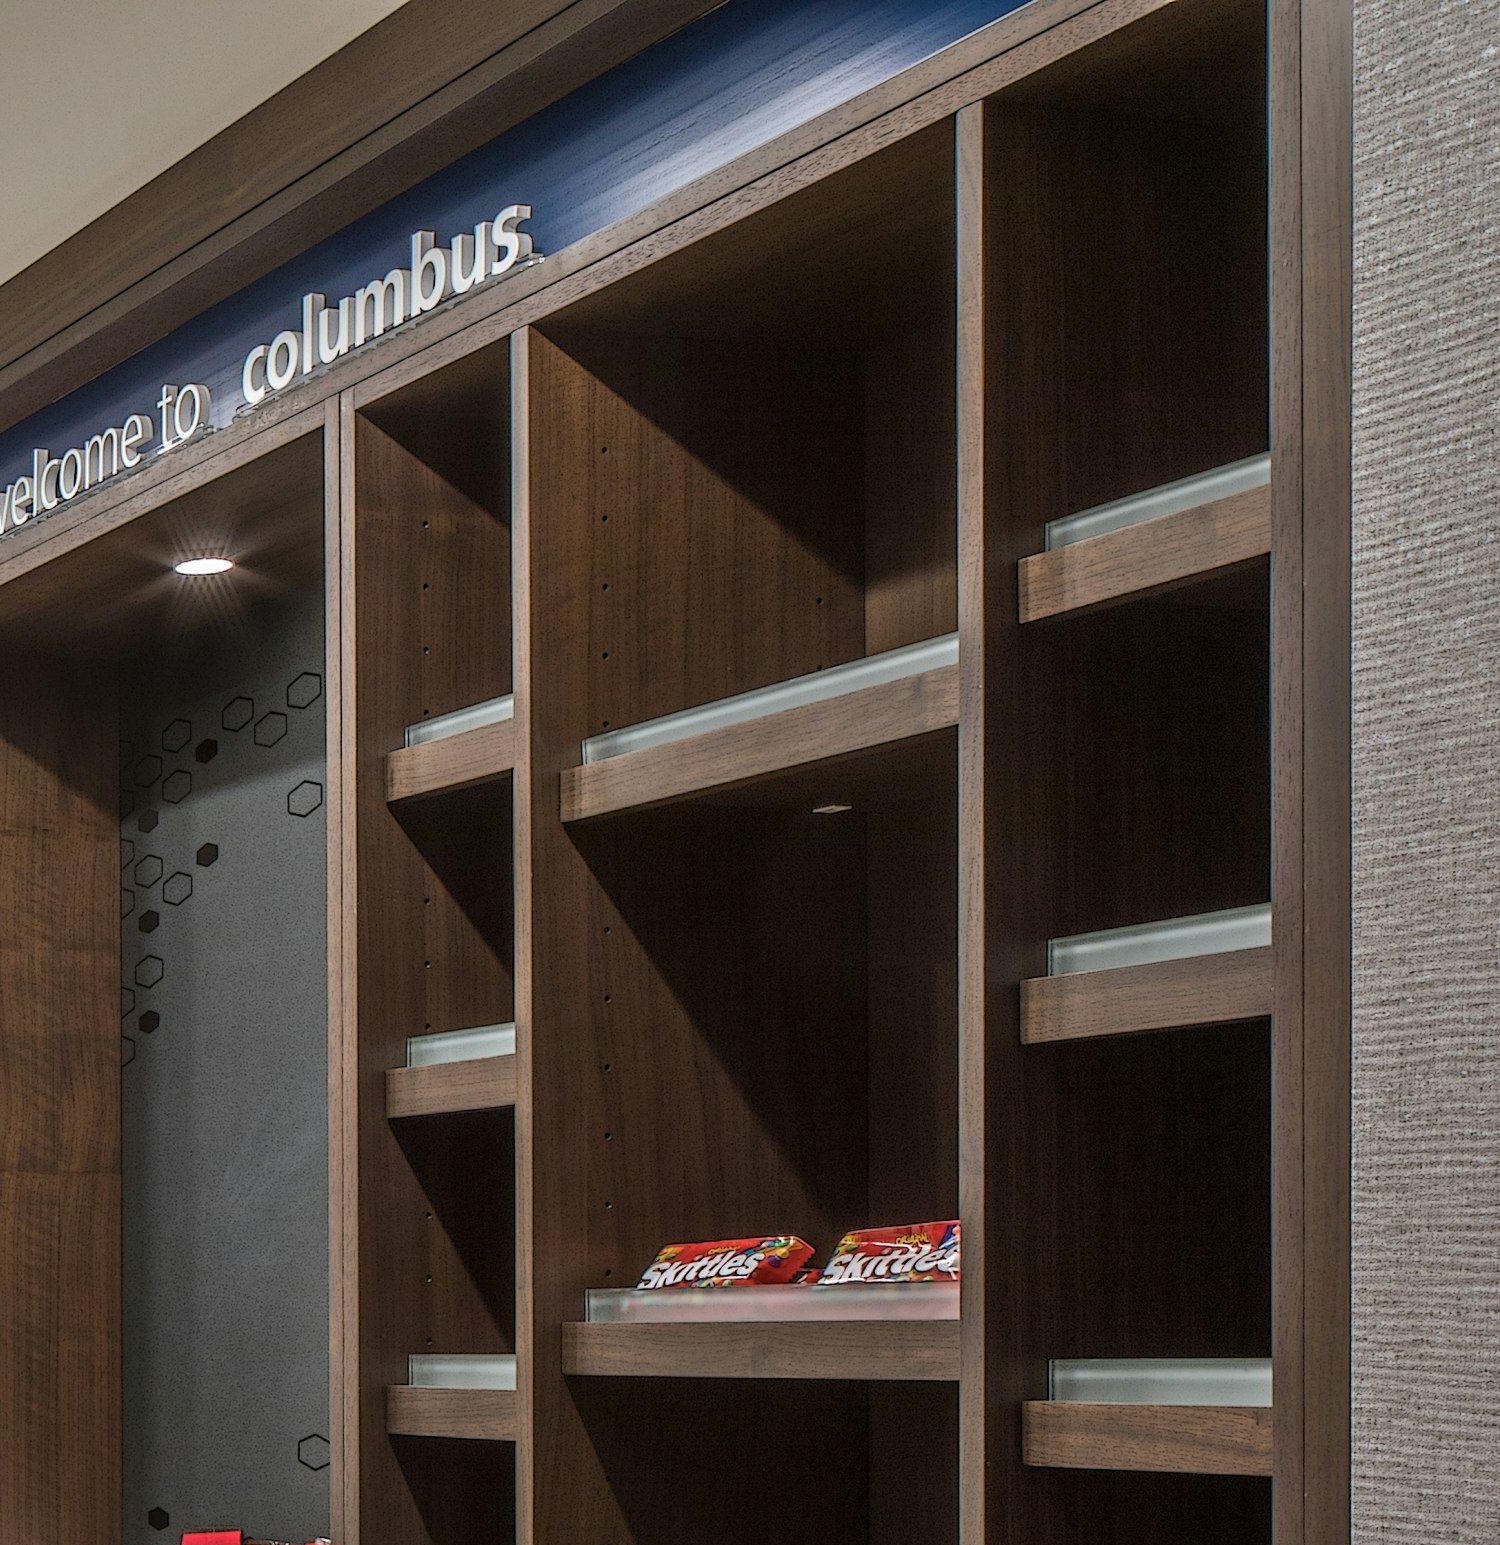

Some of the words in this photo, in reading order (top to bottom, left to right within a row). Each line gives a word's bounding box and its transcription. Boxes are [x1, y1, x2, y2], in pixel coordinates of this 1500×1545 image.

[156, 382, 211, 453] to
[241, 203, 533, 405] columbus
[636, 1250, 764, 1290] Skittles
